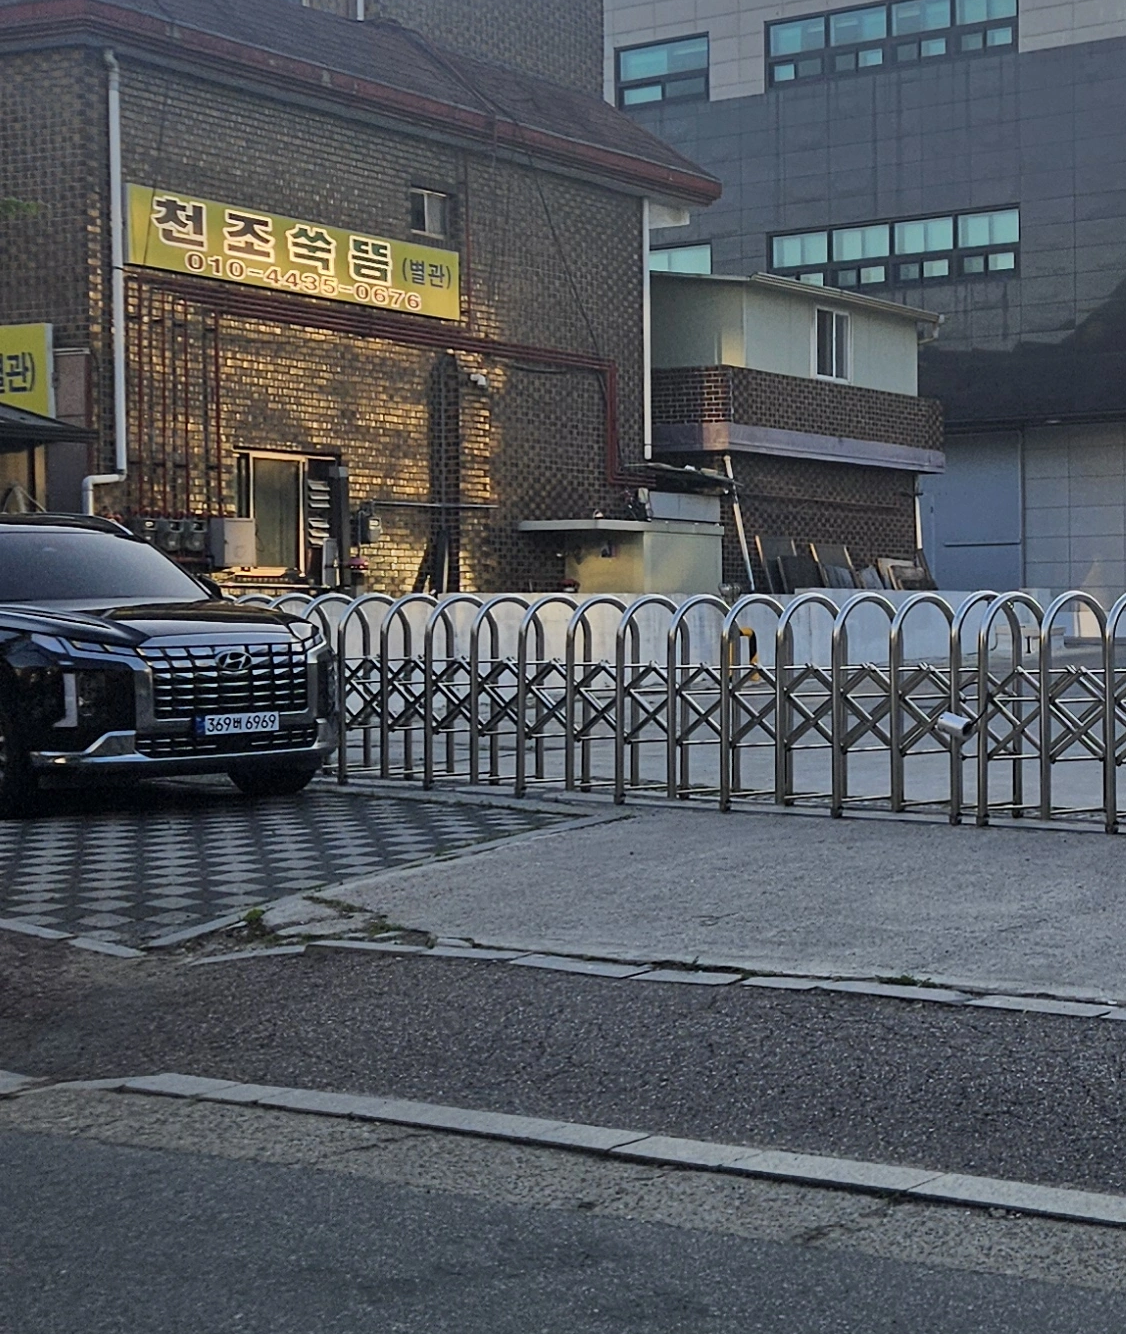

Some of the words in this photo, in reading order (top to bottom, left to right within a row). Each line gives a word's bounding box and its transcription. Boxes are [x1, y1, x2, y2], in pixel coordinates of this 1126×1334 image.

[151, 195, 393, 287] 천조쑥뜸
[402, 257, 451, 290] (별관)
[185, 252, 422, 310] 010-4435-0676
[245, 714, 276, 729] 6969
